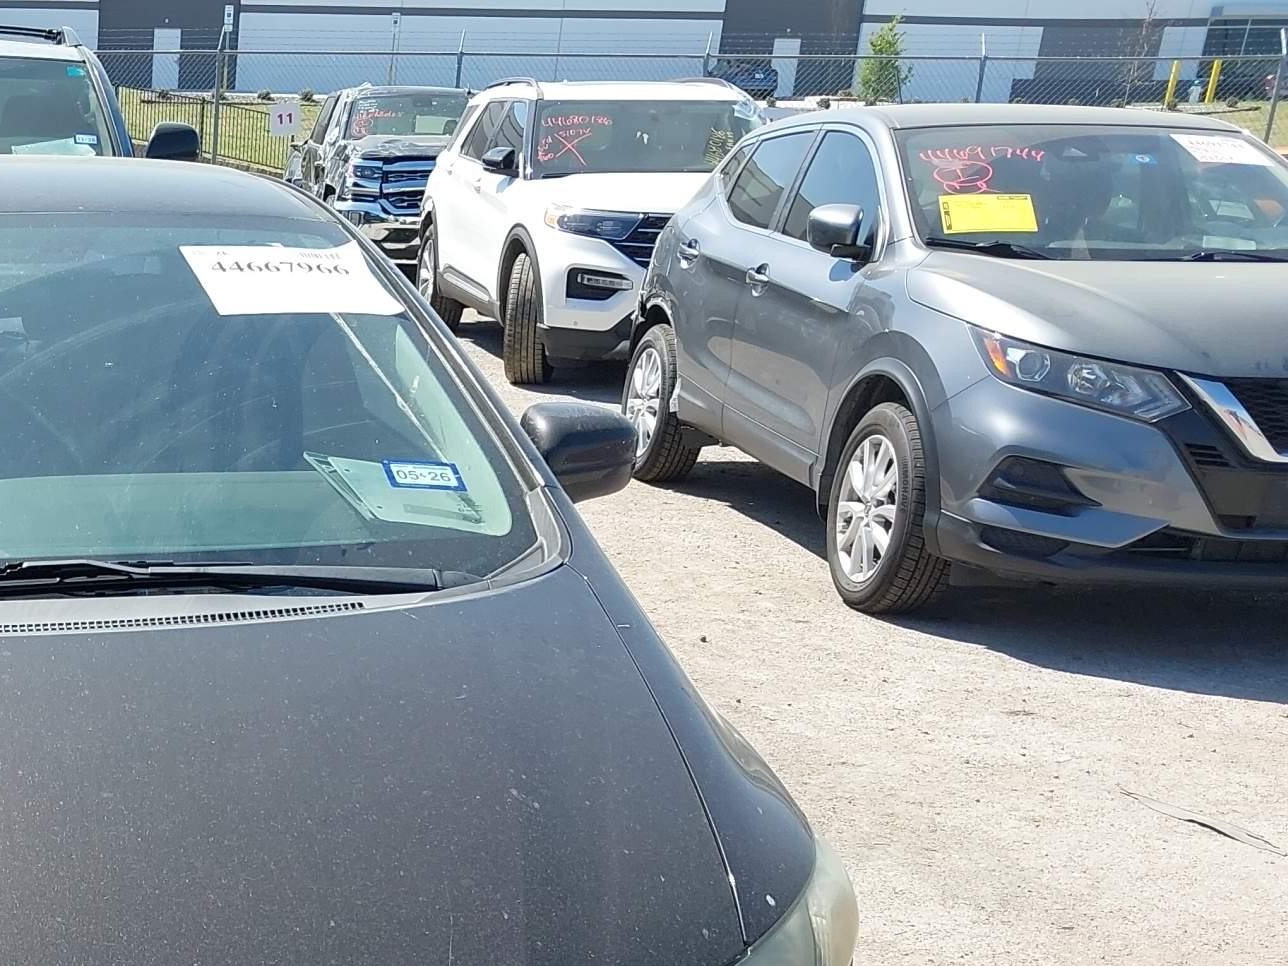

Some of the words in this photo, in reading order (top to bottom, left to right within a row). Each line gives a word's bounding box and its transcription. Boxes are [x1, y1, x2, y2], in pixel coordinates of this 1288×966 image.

[277, 113, 293, 125] 11
[920, 146, 1045, 161] 44691744
[211, 260, 350, 275] 44667966
